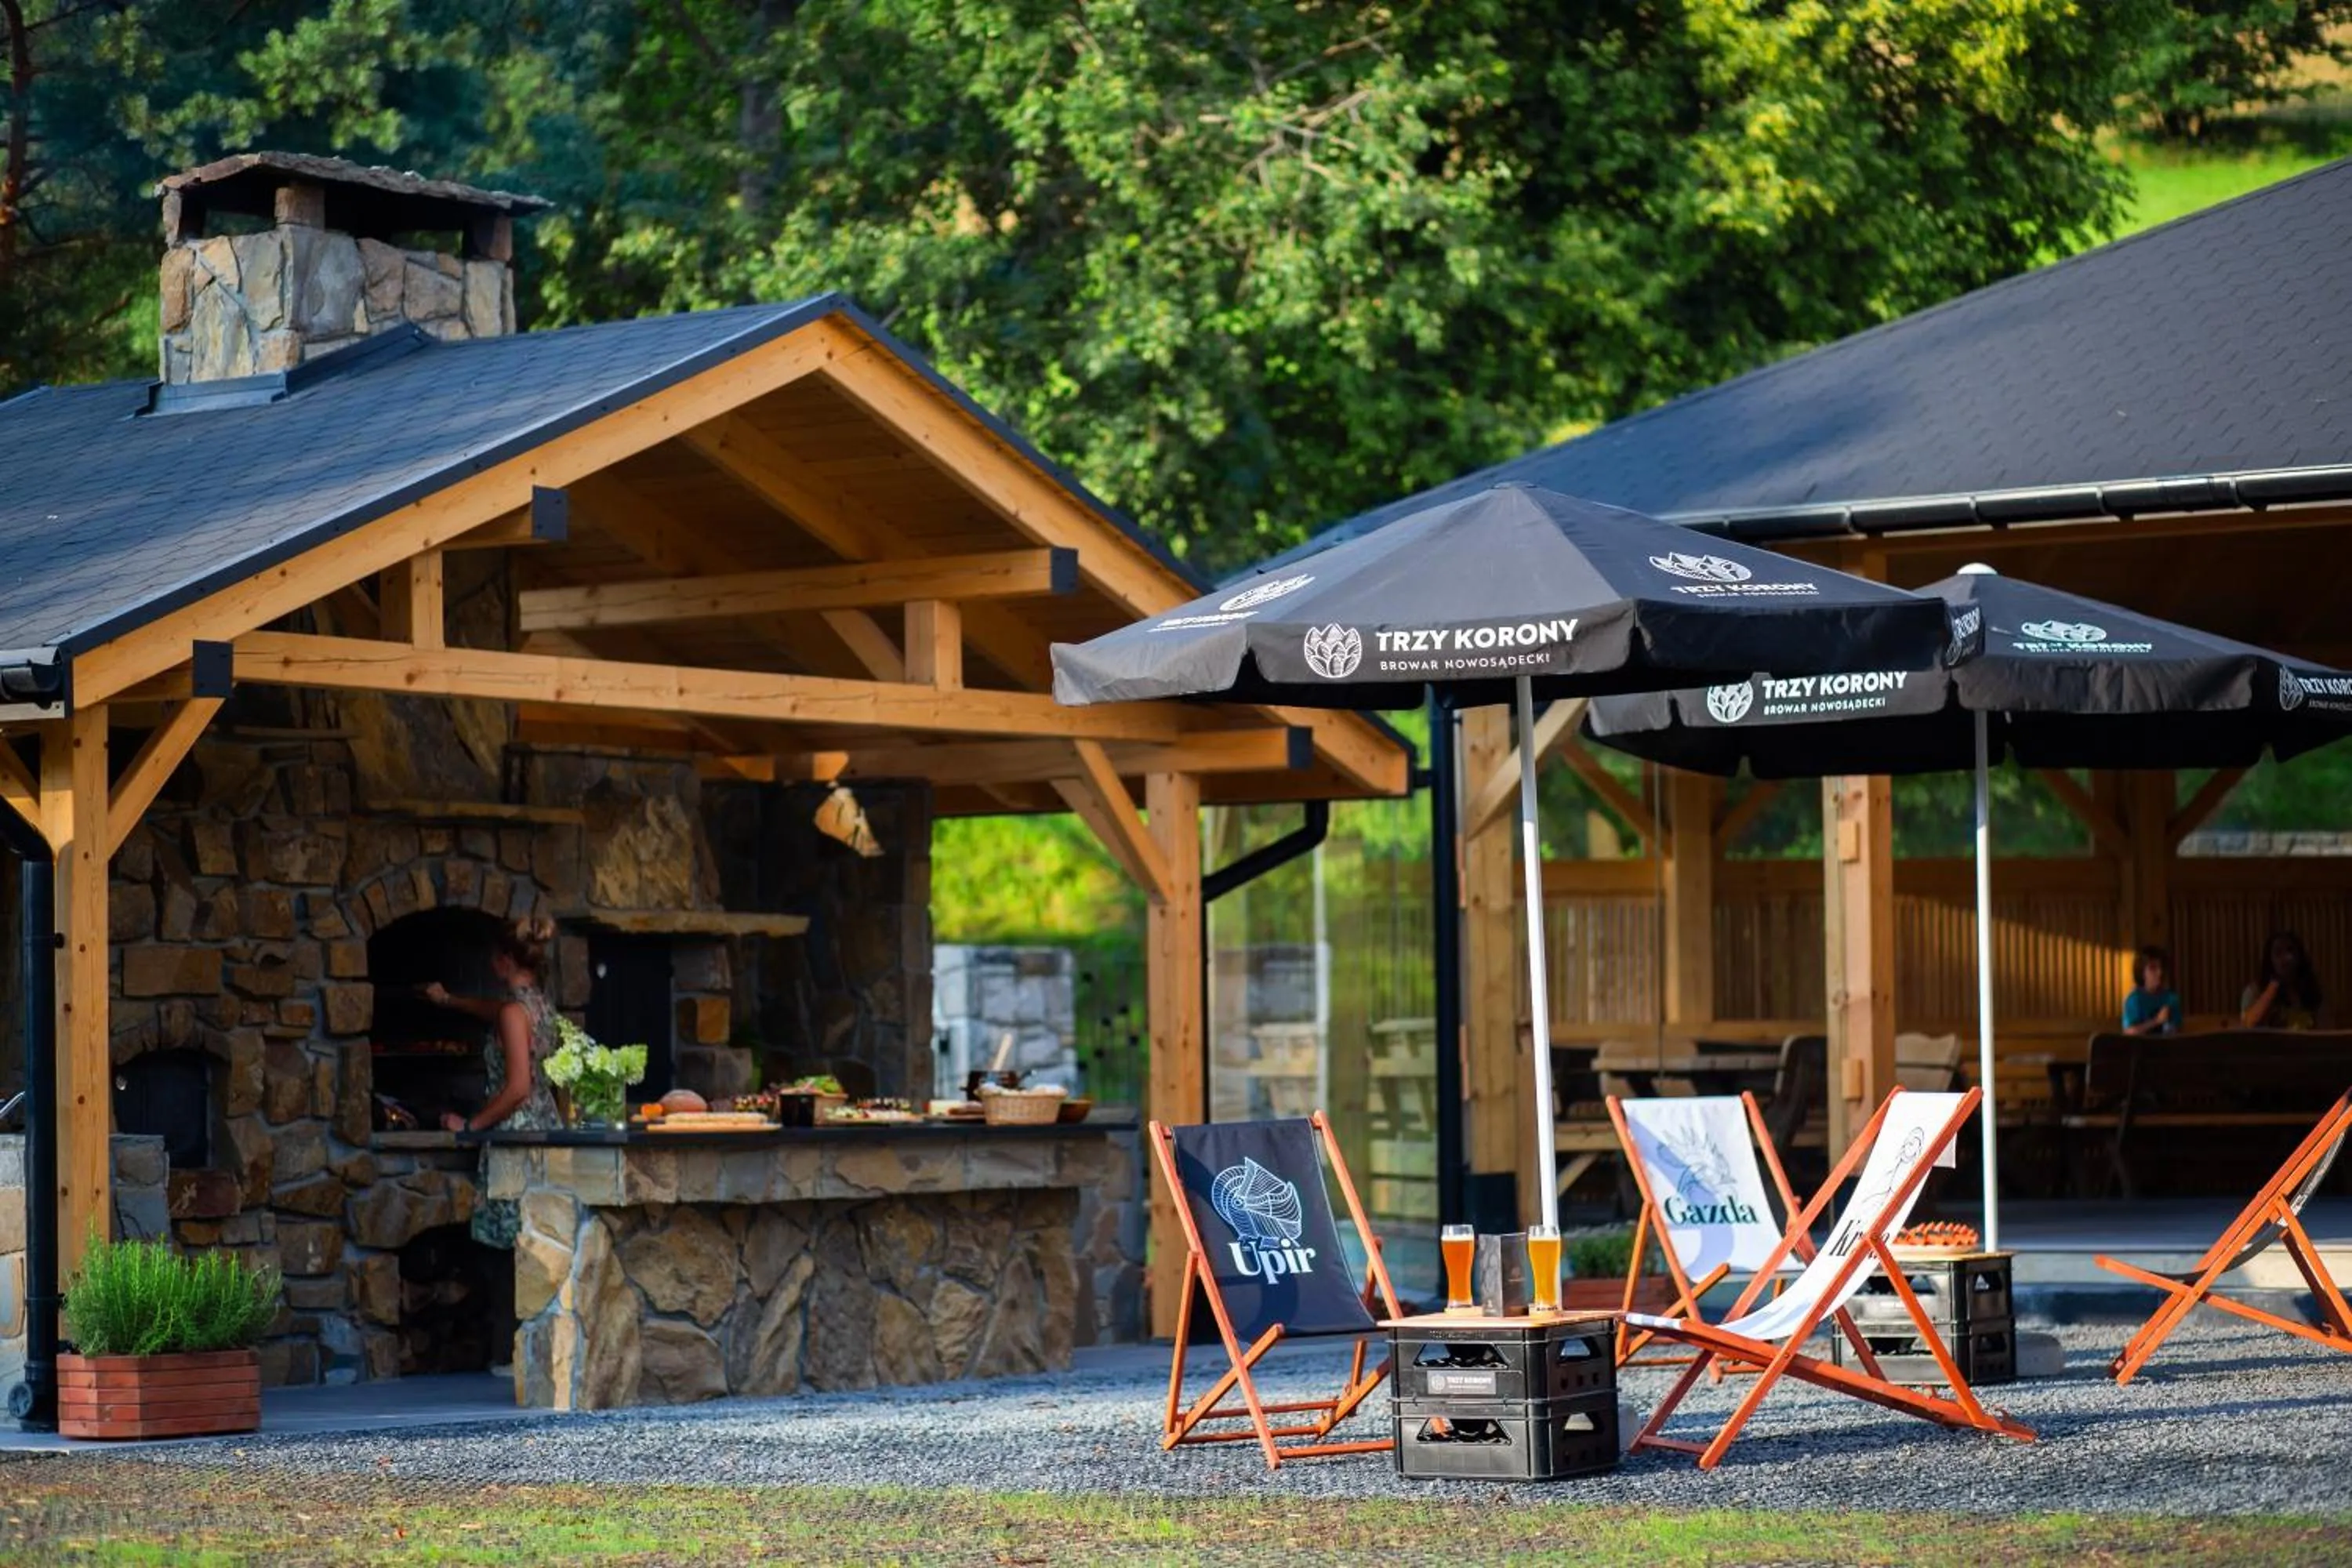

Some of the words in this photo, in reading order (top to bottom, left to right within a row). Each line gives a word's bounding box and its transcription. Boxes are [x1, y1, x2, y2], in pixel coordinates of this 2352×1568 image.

[1375, 630, 1450, 652] TRZY
[1454, 619, 1579, 650] KORONY
[1380, 660, 1439, 671] BROWAR
[1445, 652, 1551, 669] NOWOSĄDECKI
[1762, 677, 1817, 699] TRZY
[1820, 671, 1907, 696] KORONY
[1764, 702, 1807, 716] BROWAR
[1811, 697, 1886, 712] NOWOSĄDECKI
[1664, 1195, 1759, 1225] Gazda
[1228, 1238, 1316, 1284] Upir
